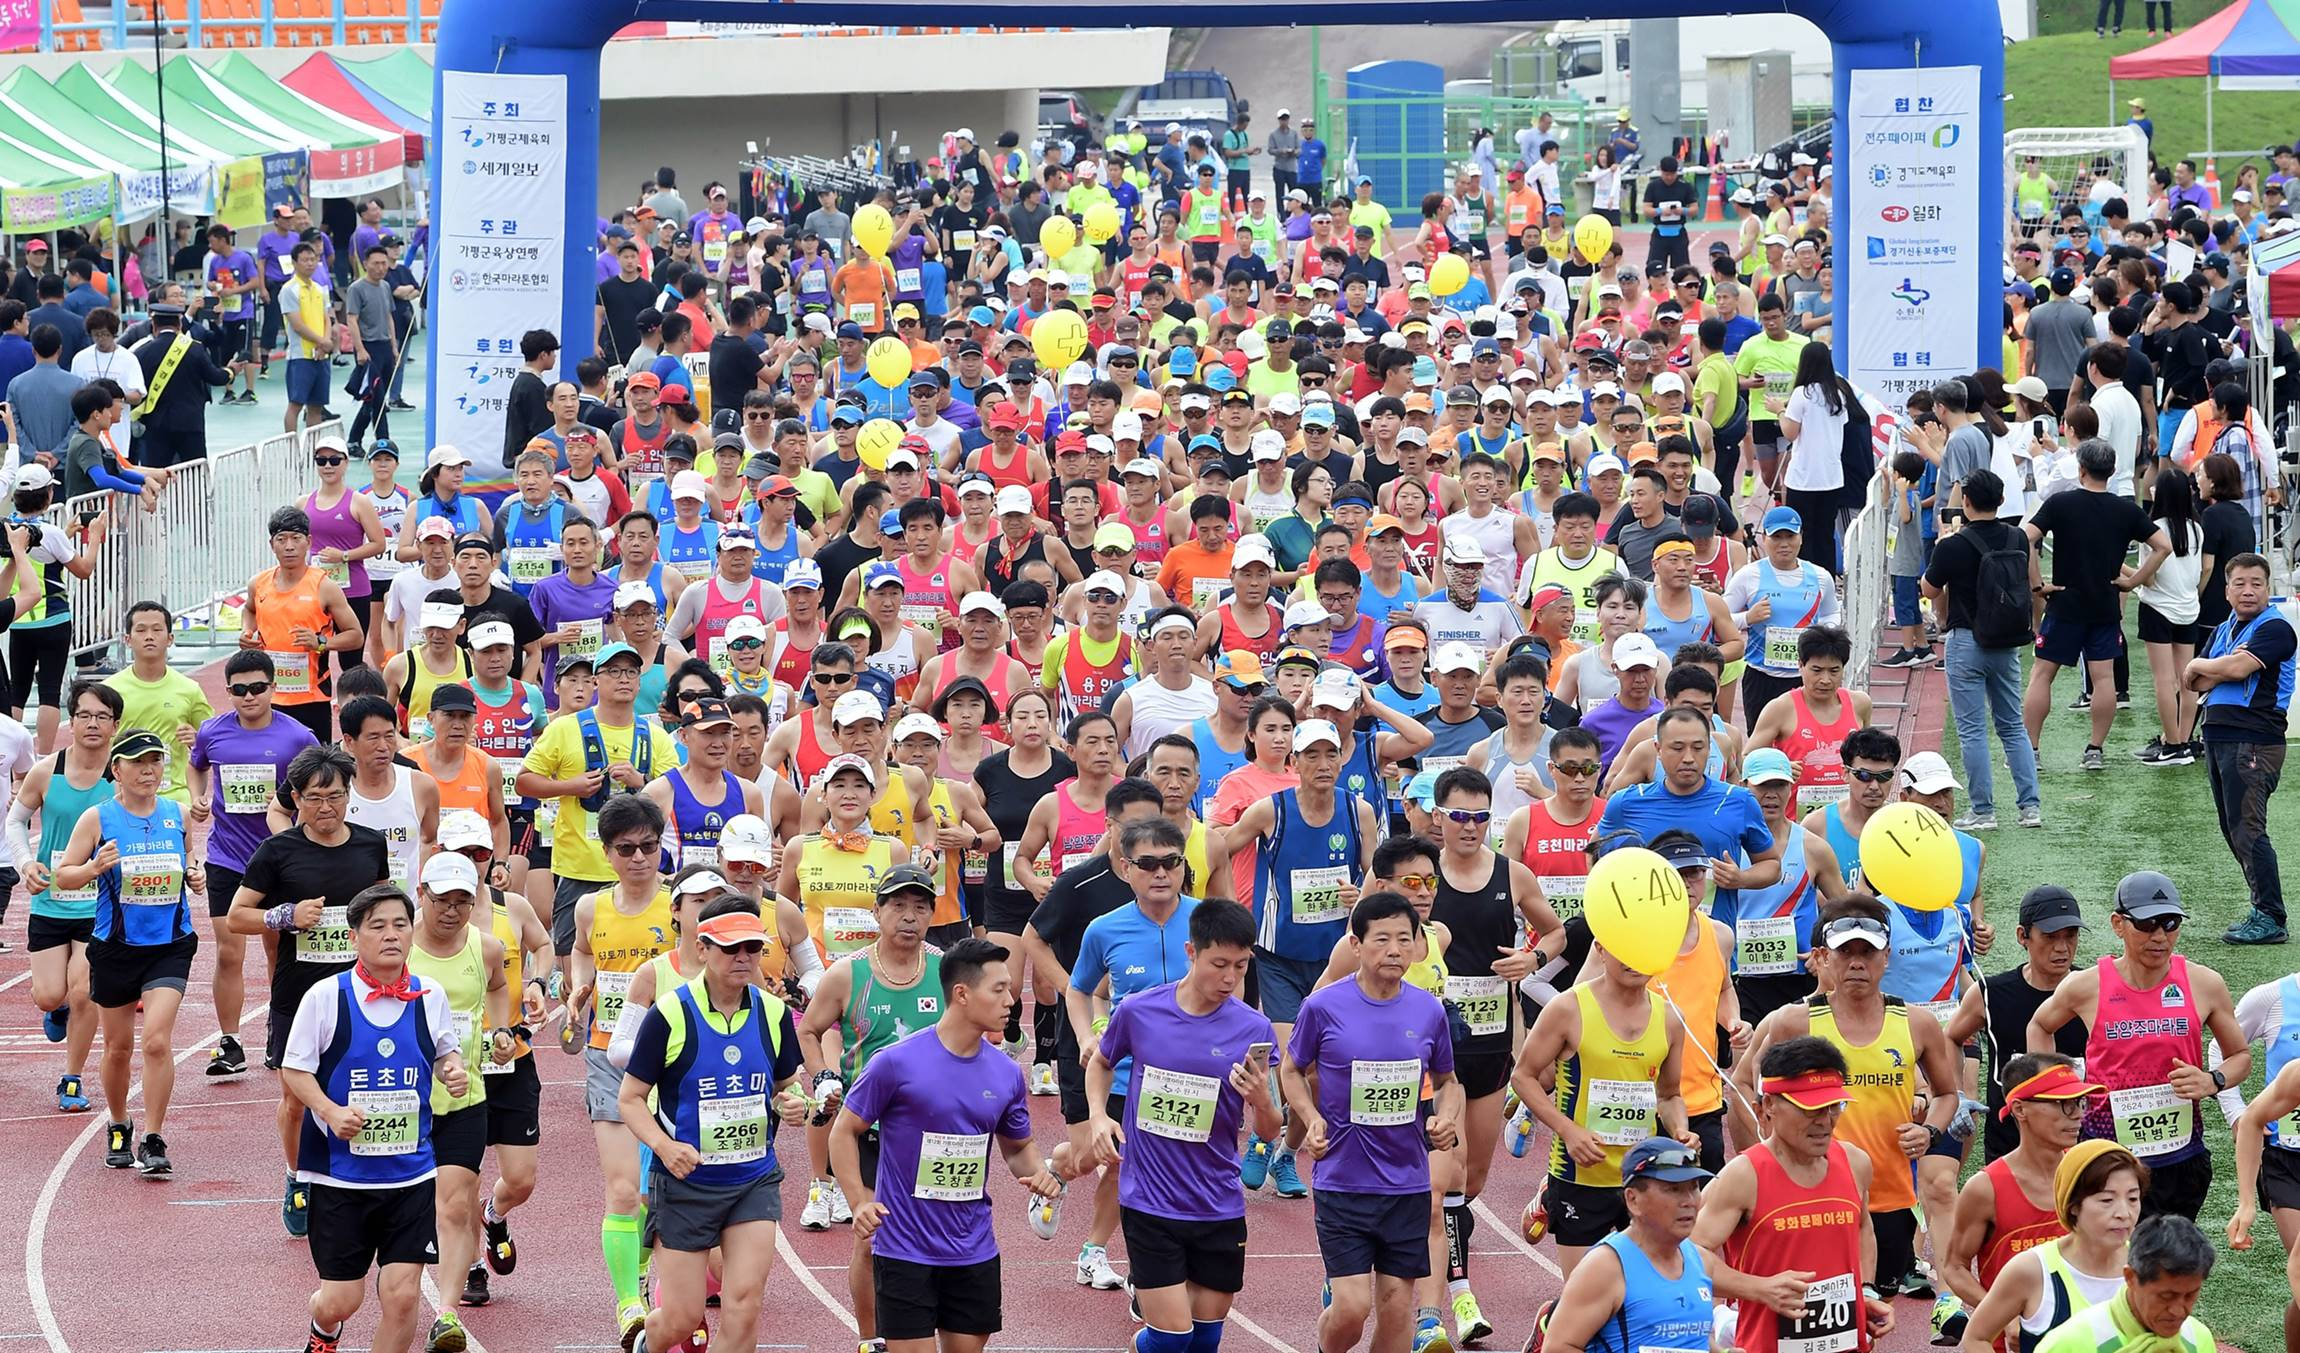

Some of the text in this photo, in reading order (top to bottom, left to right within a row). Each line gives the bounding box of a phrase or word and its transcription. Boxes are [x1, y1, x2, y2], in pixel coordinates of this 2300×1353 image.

[483, 102, 520, 117] 주최
[1895, 97, 1934, 113] 협찬
[486, 132, 550, 145] 가평군체육회
[1865, 132, 1927, 144] 전주페이퍼
[480, 161, 540, 177] 세계일보
[1896, 165, 1956, 181] 경기도체육회
[1912, 205, 1942, 222] 일화
[481, 219, 517, 235] 주관
[459, 245, 539, 260] 가평군육상연맹
[482, 272, 549, 286] 한국마라톤협회
[1896, 307, 1925, 316] 수원시
[478, 338, 514, 354] 후원
[1893, 352, 1931, 367] 협력
[688, 358, 708, 377] km
[374, 505, 403, 515] OREA
[517, 562, 545, 570] 2154
[1438, 629, 1481, 639] FINISHER
[1772, 643, 1797, 653] 203
[276, 667, 301, 677] 866
[483, 718, 517, 734] 용인
[230, 784, 265, 795] 2186
[684, 830, 723, 843] 보스턴마
[1537, 838, 1588, 854] 춘천마라
[131, 875, 171, 887] 2801
[1611, 866, 1683, 919] 1:40
[307, 928, 350, 942] 2146
[834, 930, 877, 941] 2865
[311, 940, 349, 952] 여광섭
[1745, 940, 1786, 953] 2033
[1748, 952, 1784, 964] 이한용
[604, 997, 625, 1010] 22
[871, 1004, 891, 1015] 가평
[1456, 1000, 1498, 1013] 2123
[2104, 1016, 2189, 1041] 남양주마라톤
[350, 1067, 418, 1090] 돈초마
[698, 1072, 767, 1099] 돈초마
[1364, 1087, 1411, 1101] 2289
[1151, 1096, 1201, 1116] 2121
[1600, 1106, 1646, 1121] 2308
[362, 1116, 408, 1131] 2244
[1153, 1110, 1196, 1128] 고지훈
[2128, 1111, 2181, 1131] 2047
[364, 1130, 405, 1144] 이상기
[714, 1122, 759, 1140] 2266
[2134, 1126, 2179, 1142] 박병균
[718, 1136, 756, 1151] 조광래
[931, 1161, 979, 1175] 2122
[934, 1175, 973, 1188] 오창훈
[1773, 1211, 1855, 1231] 광화문페이싱팀
[1806, 1276, 1849, 1297] 스메이커
[1653, 1321, 1712, 1340] 가평마라톤
